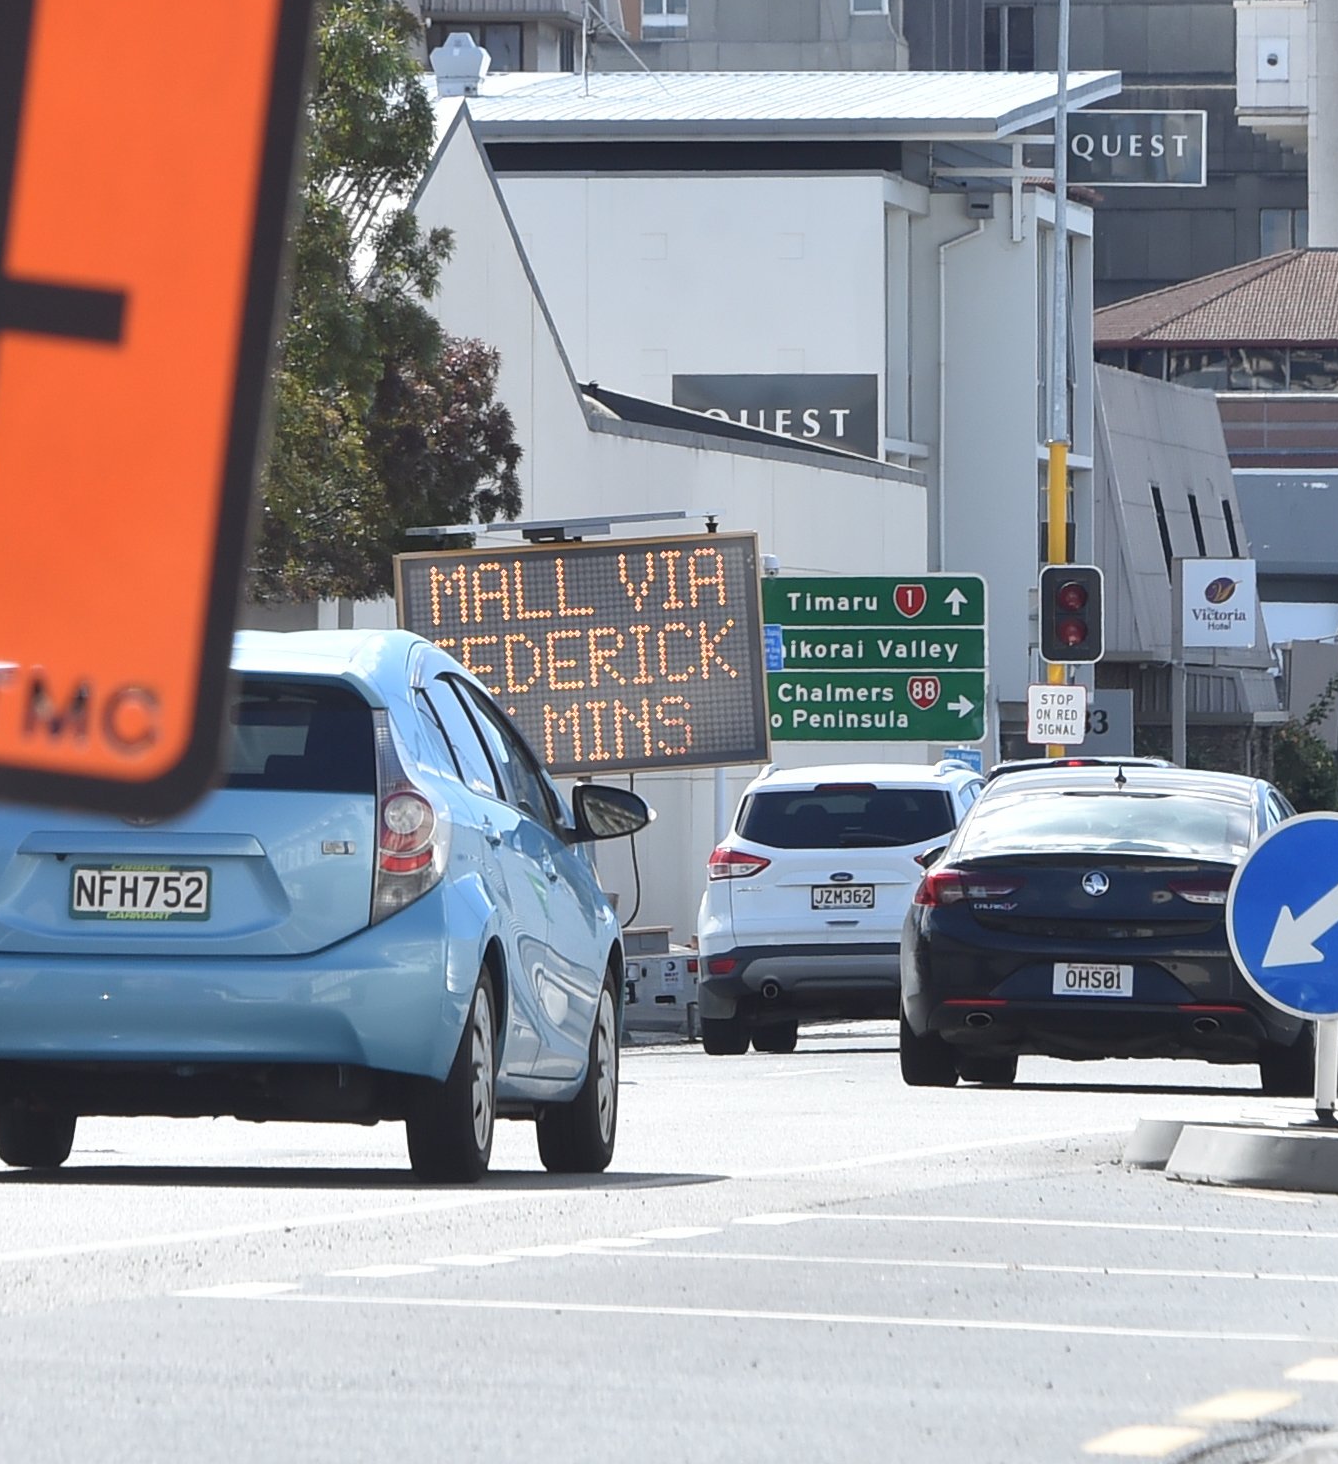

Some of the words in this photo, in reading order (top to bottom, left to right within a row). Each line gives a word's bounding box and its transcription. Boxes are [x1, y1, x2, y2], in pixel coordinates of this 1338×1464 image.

[1071, 133, 1189, 162] QUEST
[429, 558, 595, 626] MALL
[617, 546, 727, 613] VIA
[787, 592, 878, 612] Timaru
[905, 589, 913, 608] 1
[1191, 608, 1247, 621] Victoria
[1207, 621, 1232, 631] Hotel
[432, 618, 738, 696] EDERICK
[877, 640, 959, 663] Valley
[777, 683, 894, 703] Chalmers
[912, 681, 936, 701] 88
[1041, 694, 1074, 706] STOP
[792, 709, 909, 729] Peninsula
[1036, 709, 1053, 721] ON
[1056, 710, 1078, 721] RED
[543, 695, 694, 764] MINS
[1036, 723, 1076, 736] SIGNAL
[75, 874, 205, 910] NFH752
[814, 889, 872, 905] JZM362
[1065, 969, 1122, 990] OHS01
